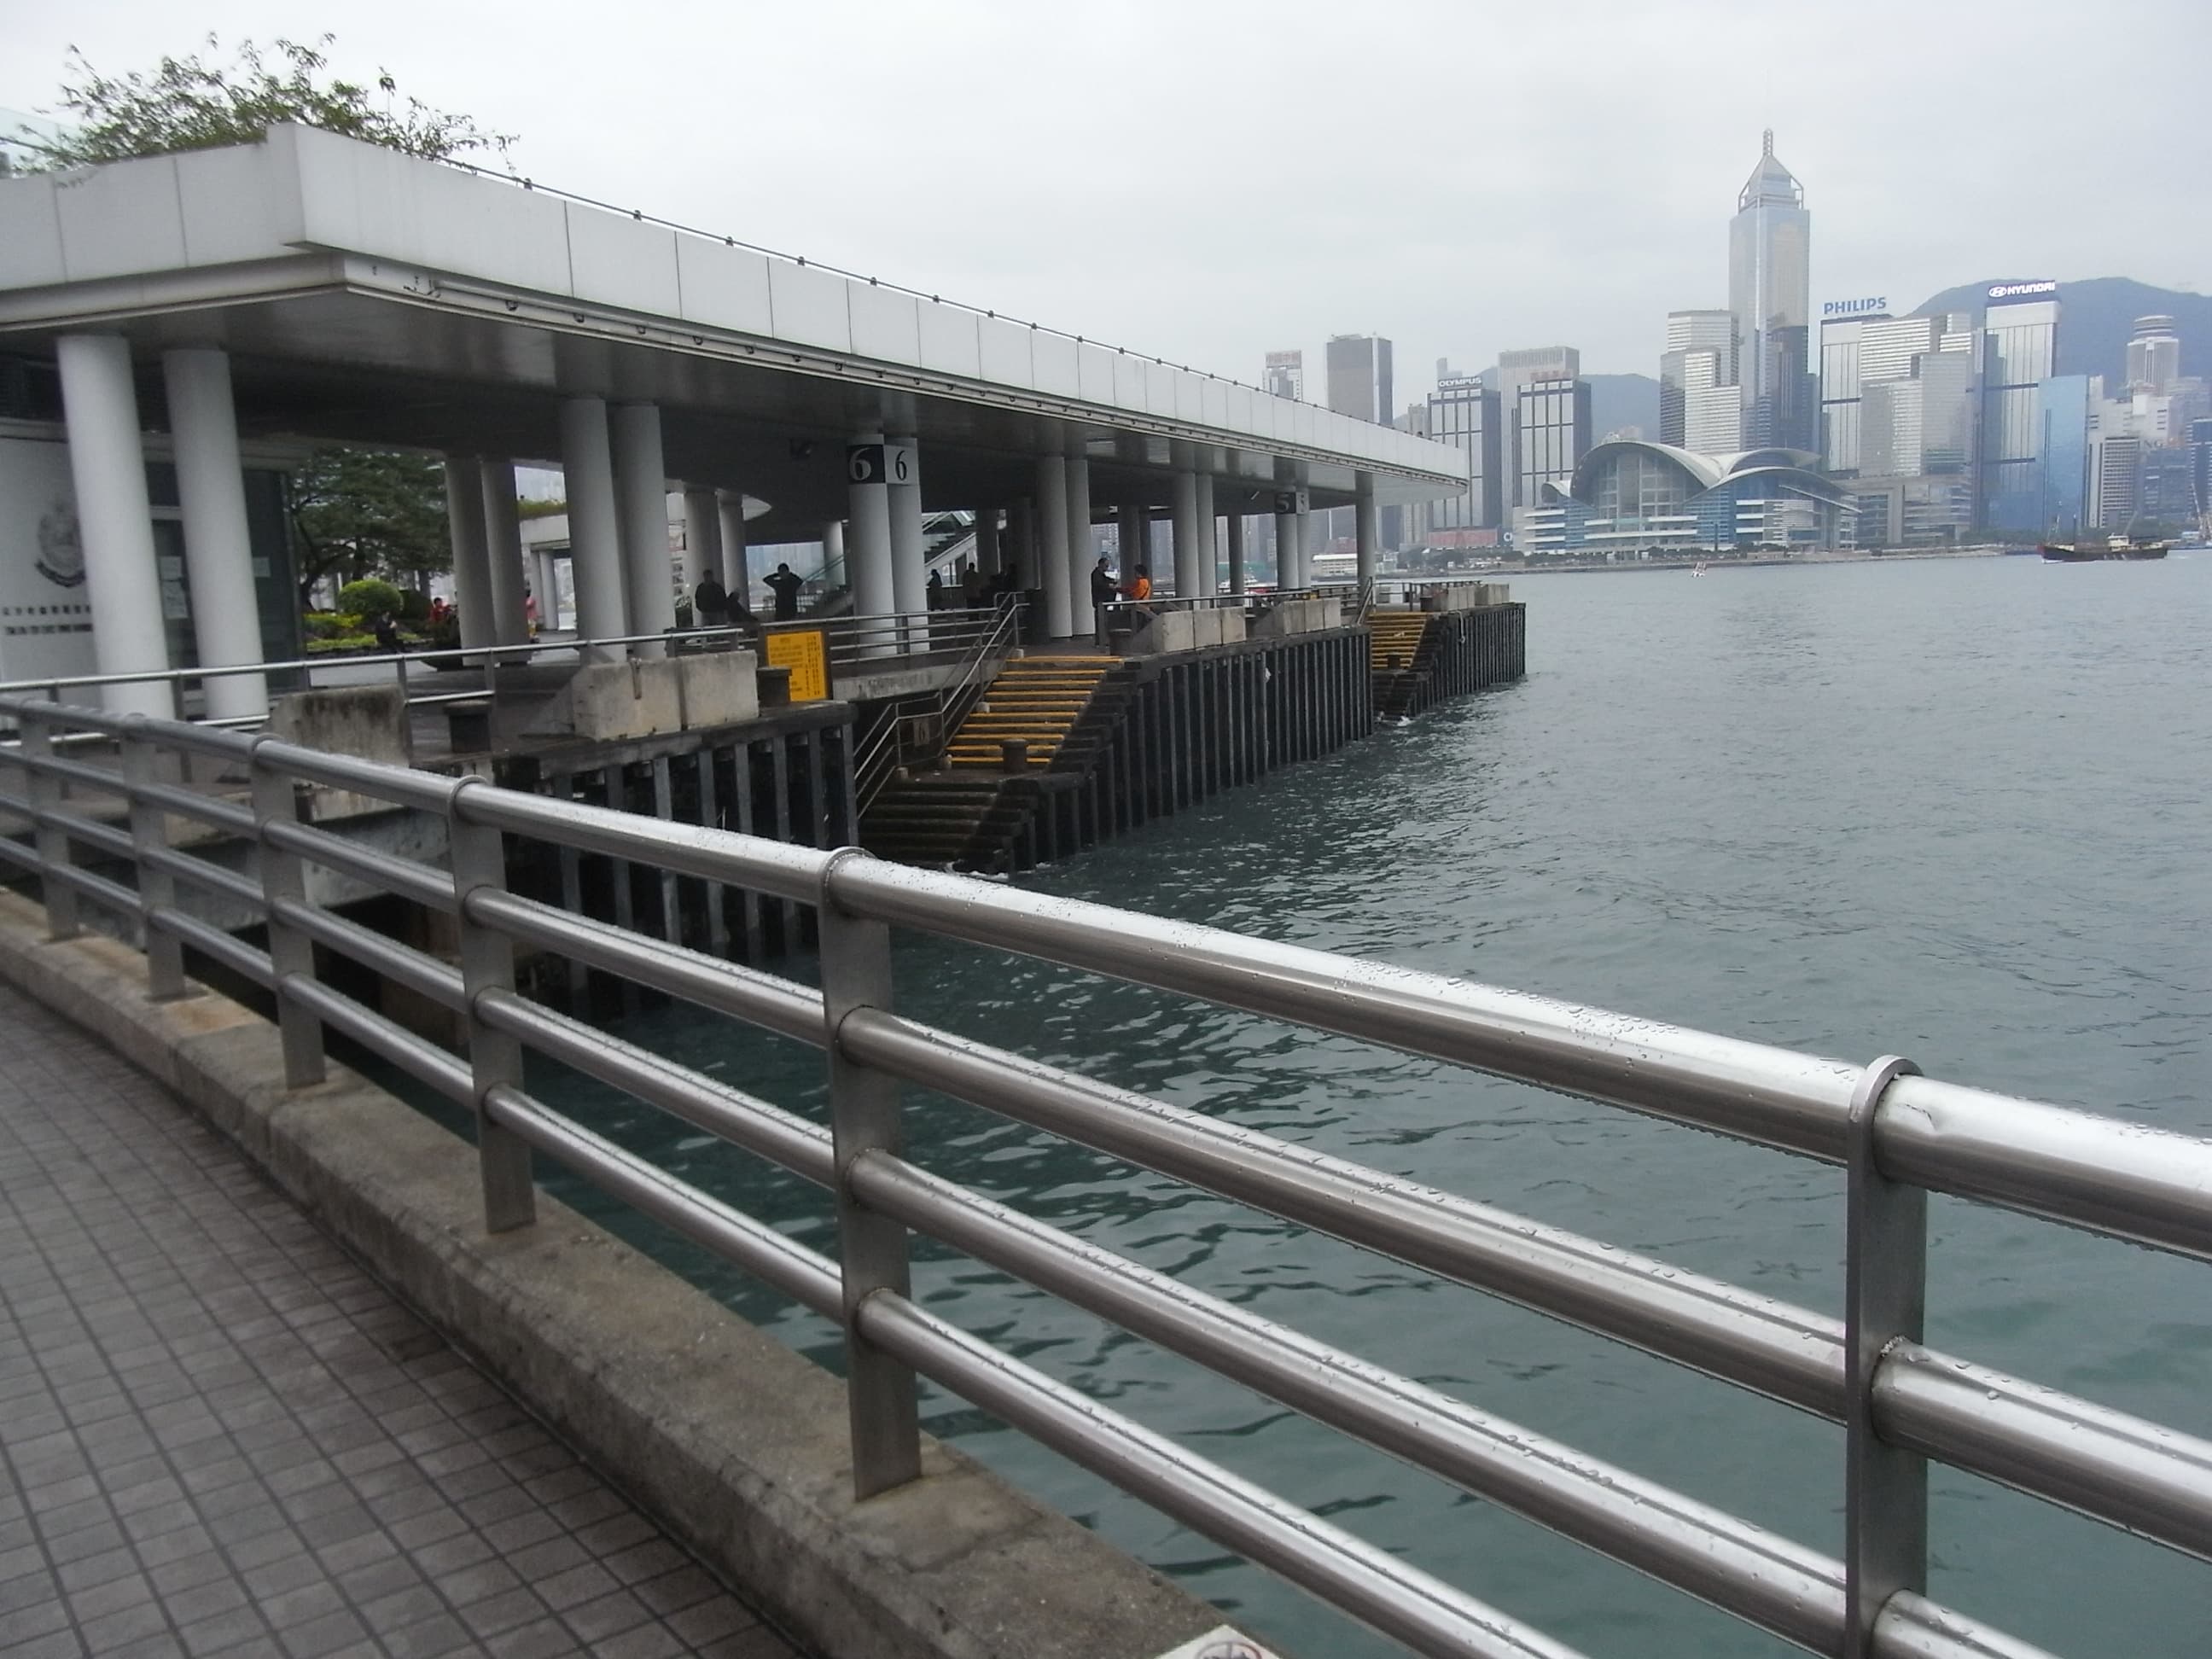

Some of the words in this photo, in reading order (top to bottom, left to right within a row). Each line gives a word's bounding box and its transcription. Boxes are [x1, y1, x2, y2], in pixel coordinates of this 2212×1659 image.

[2007, 282, 2055, 295] HYUNDAI
[1825, 297, 1886, 315] PHILIPS
[1439, 376, 1481, 387] OLYMPUS
[849, 447, 871, 480] 6
[895, 450, 906, 480] 6
[1277, 494, 1289, 513] 5
